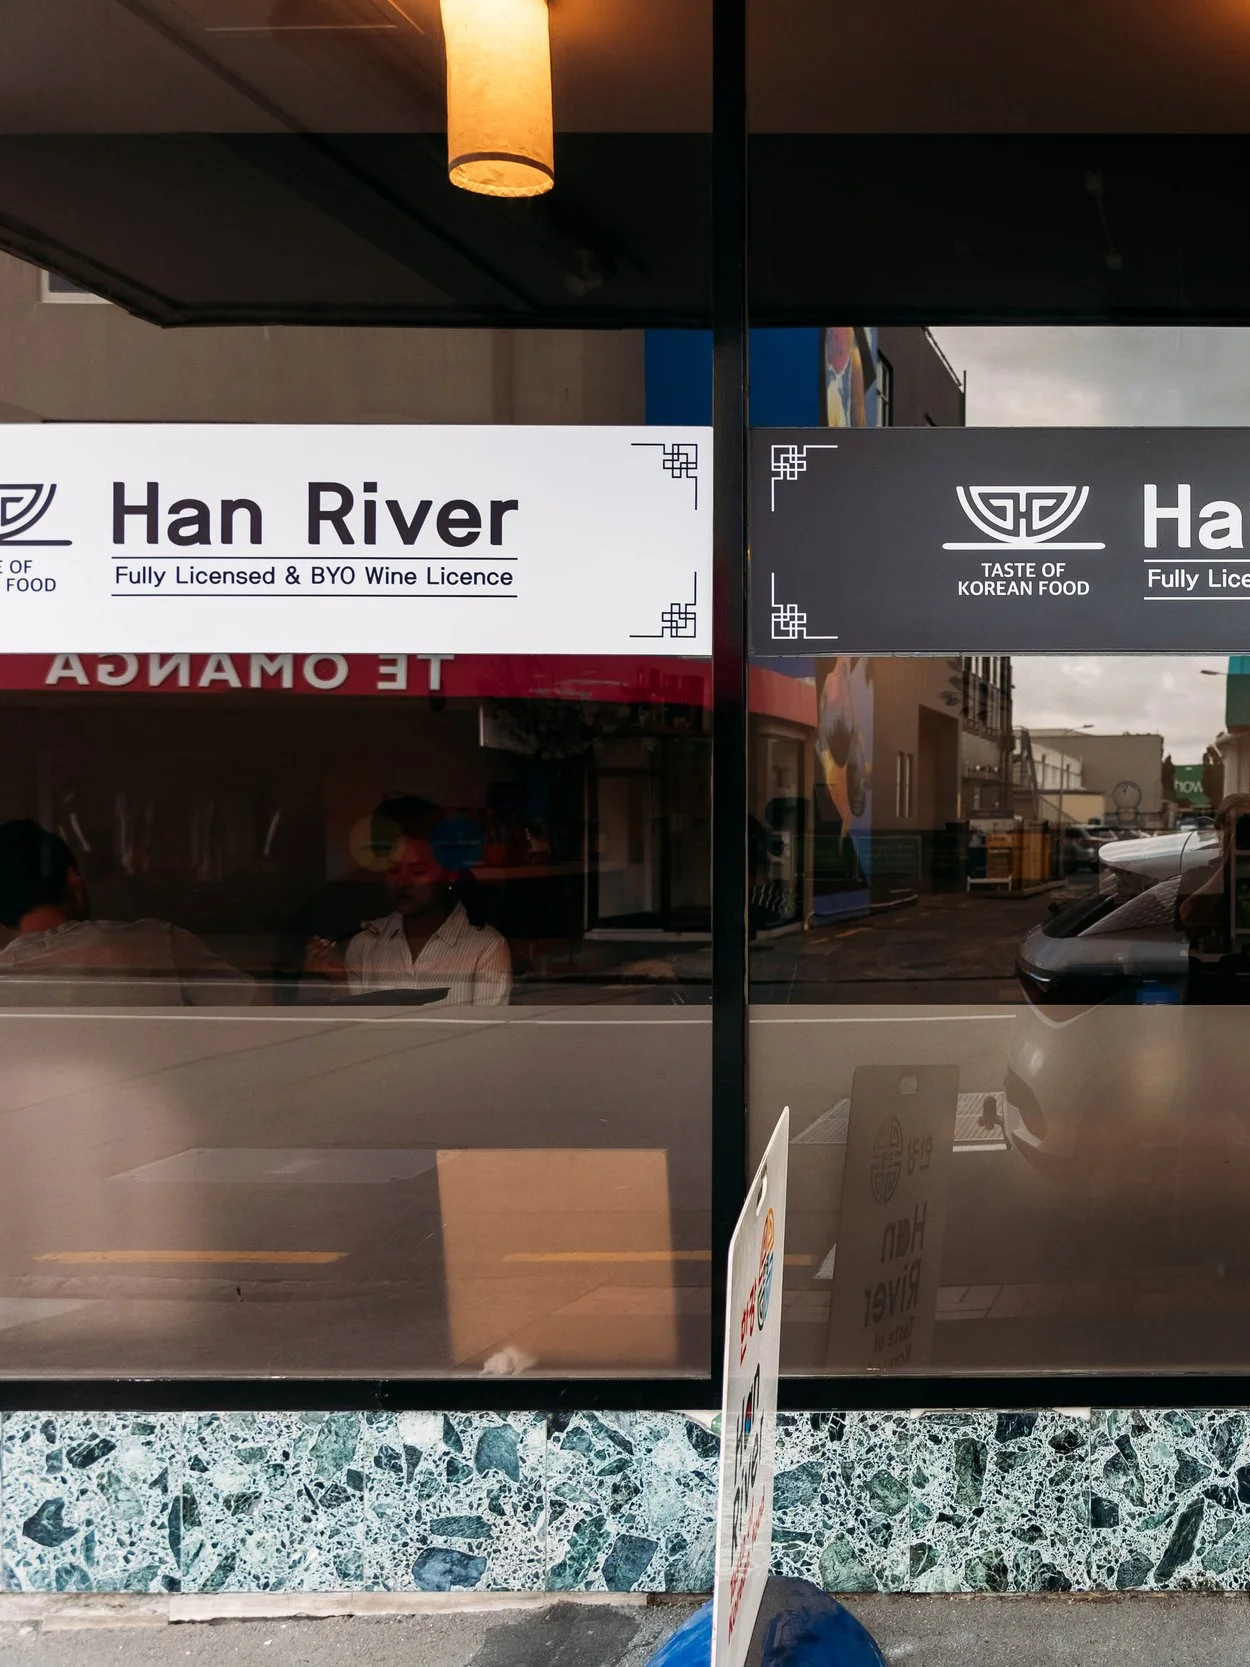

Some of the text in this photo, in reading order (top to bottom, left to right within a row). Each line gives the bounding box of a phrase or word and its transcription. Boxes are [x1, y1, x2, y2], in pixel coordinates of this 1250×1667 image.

[112, 482, 519, 547] Han River
[9, 559, 33, 574] OF
[980, 562, 1067, 578] TASTE OF
[115, 565, 514, 588] Fully Licensed & BYO Wine Licence
[1148, 568, 1200, 592] Fully
[6, 577, 57, 593] FOOD
[958, 580, 1090, 596] KOREAN FOOD
